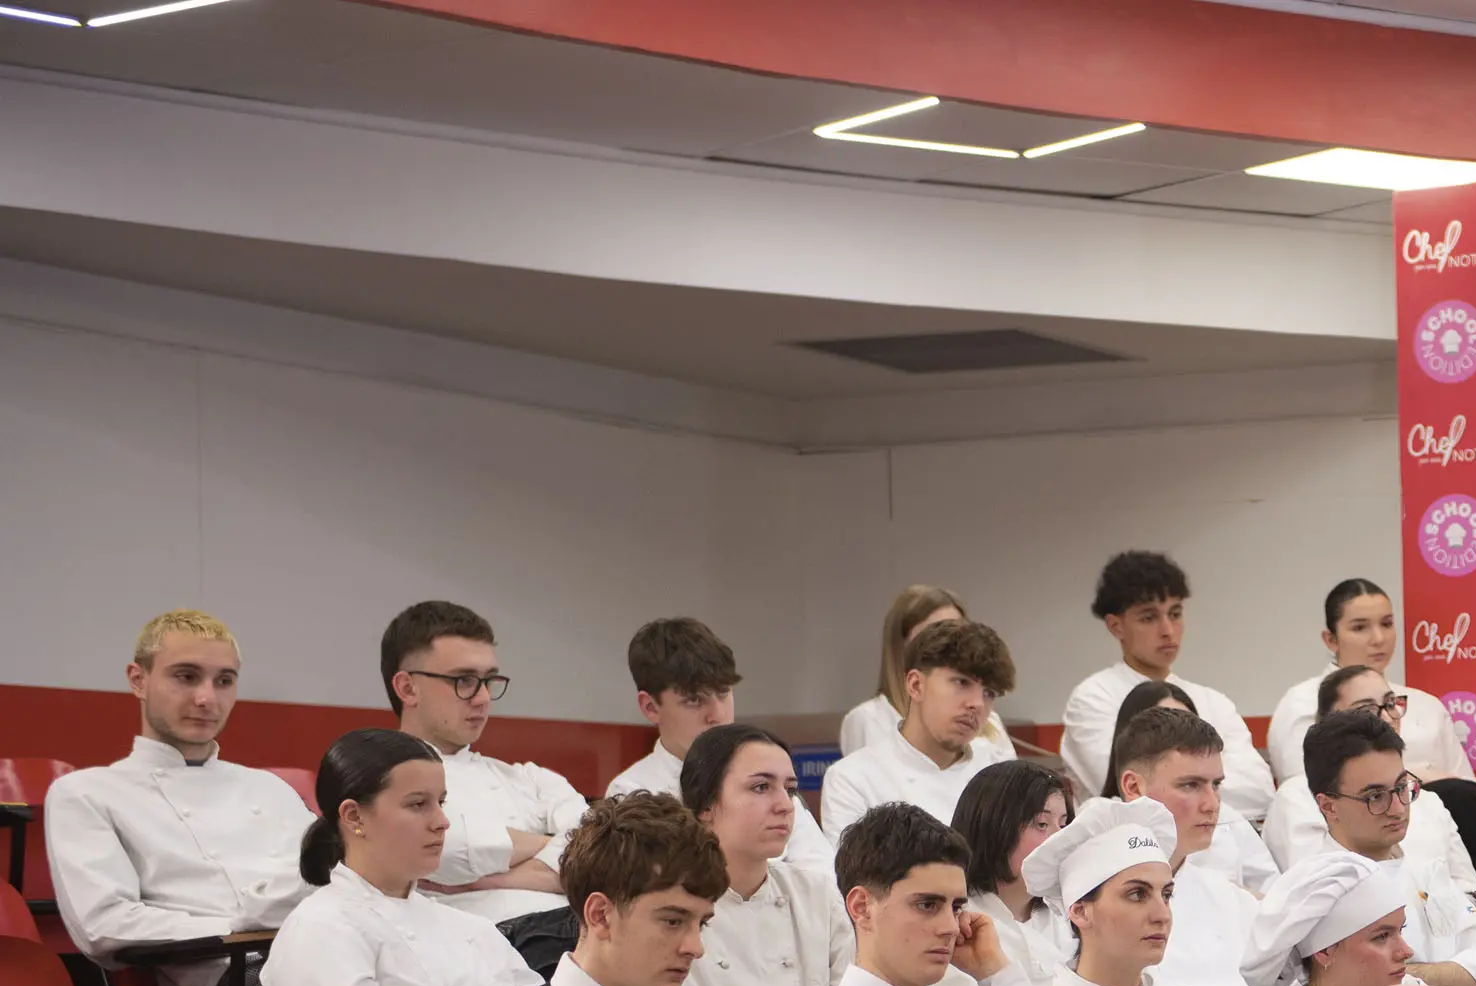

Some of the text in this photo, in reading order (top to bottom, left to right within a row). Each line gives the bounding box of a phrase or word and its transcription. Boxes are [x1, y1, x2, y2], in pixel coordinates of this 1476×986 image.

[1402, 220, 1462, 274] Chef
[1407, 415, 1467, 467] Chef
[1412, 612, 1470, 664] Chef
